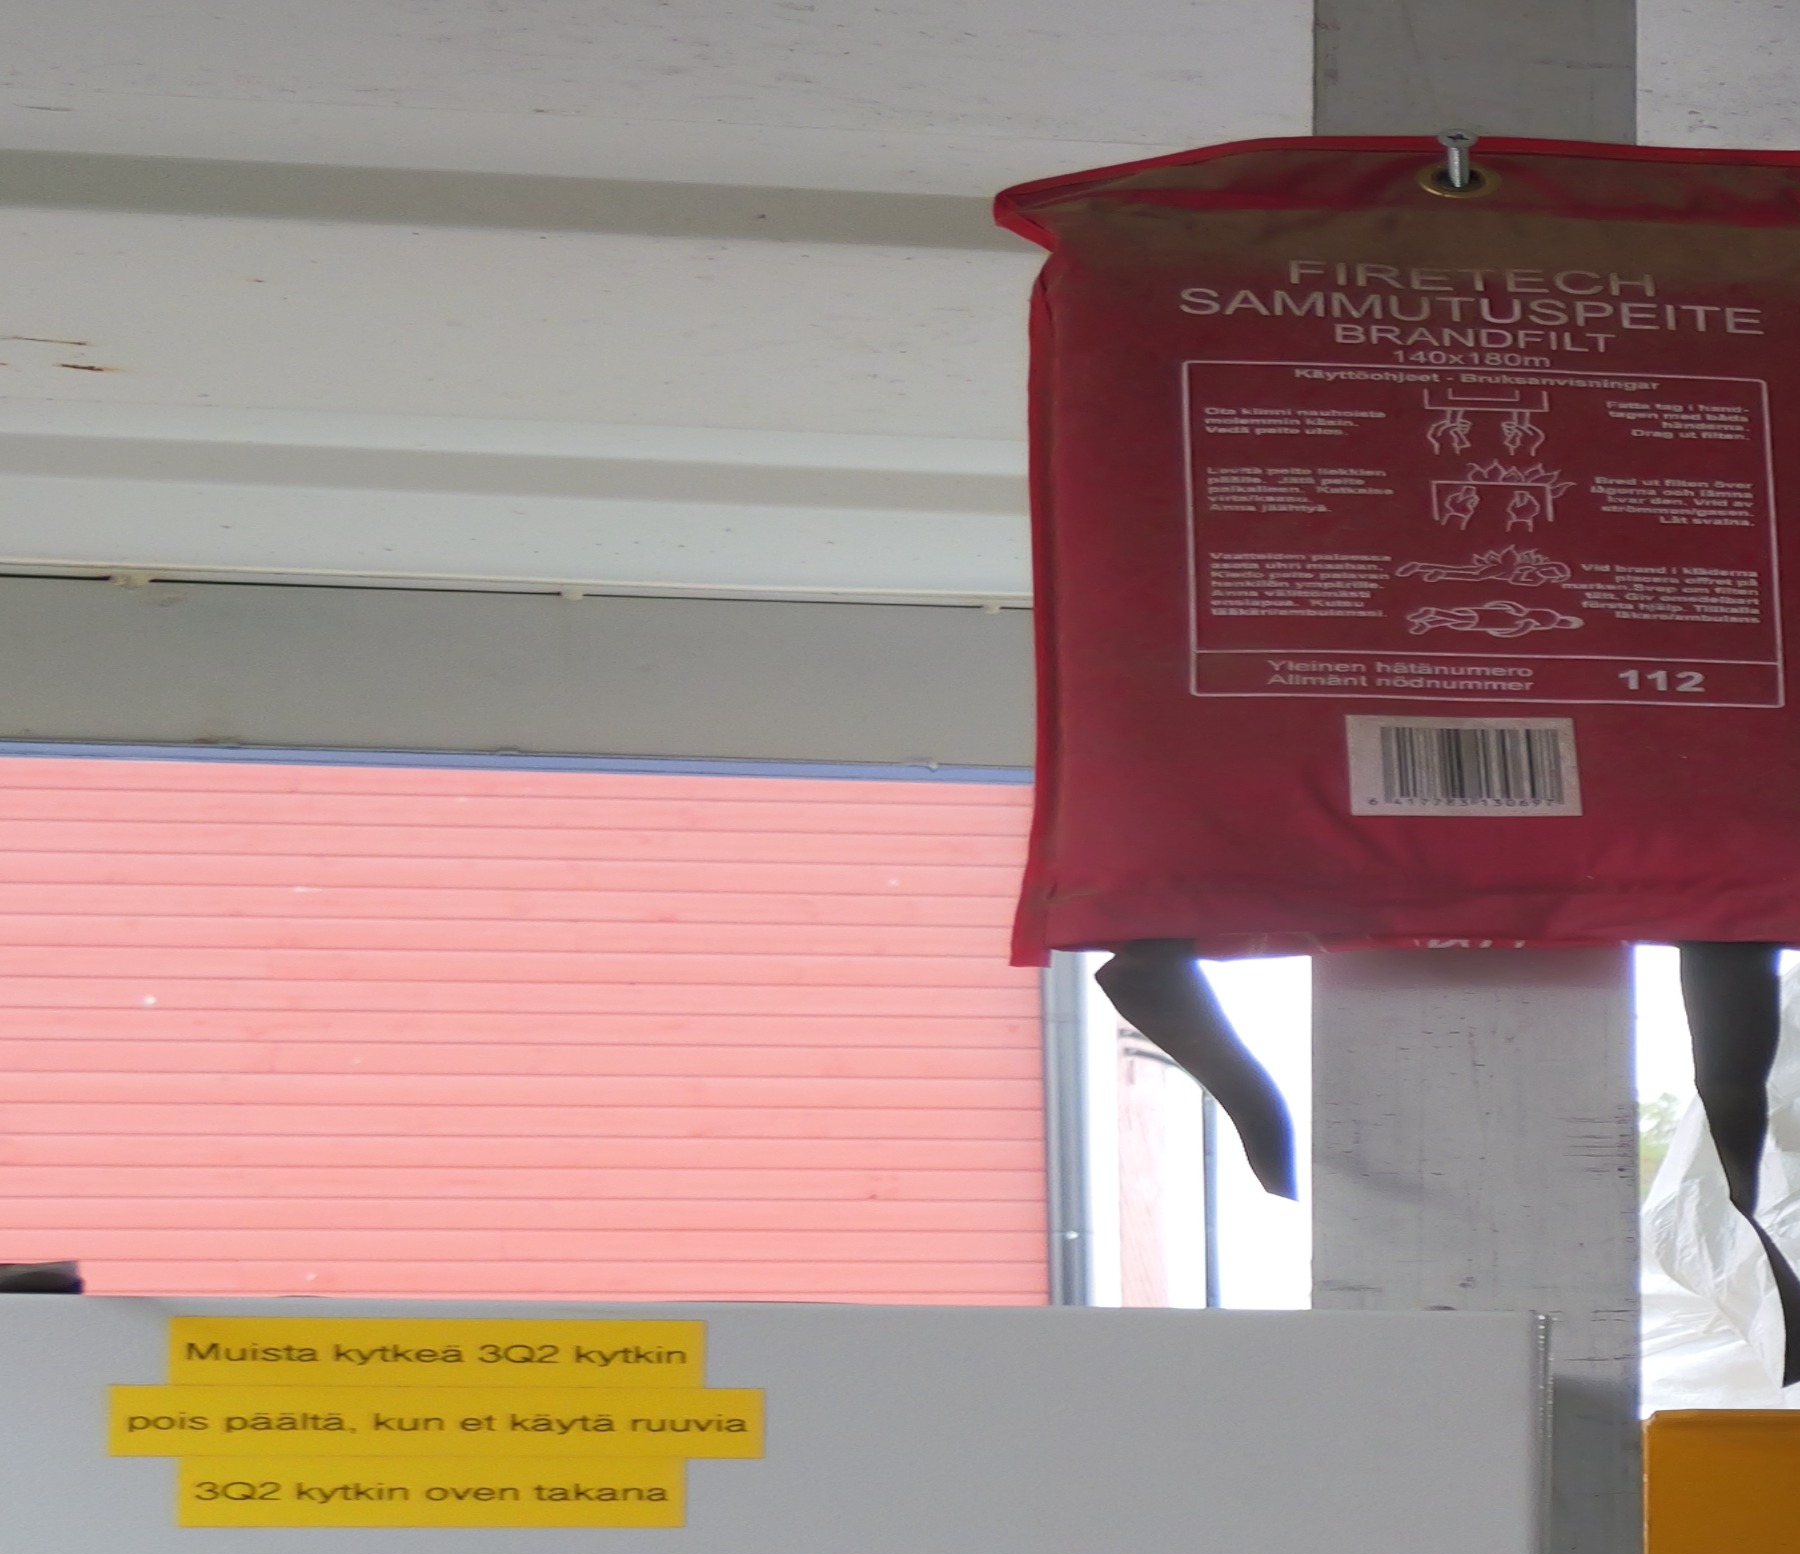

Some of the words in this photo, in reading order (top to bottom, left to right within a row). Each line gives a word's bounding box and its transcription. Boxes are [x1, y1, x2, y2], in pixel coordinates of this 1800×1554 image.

[1288, 260, 1657, 298] FIRETECH
[1178, 287, 1765, 336] SAMMUTUSPEITE
[1333, 323, 1618, 353] BRANDFILT
[1391, 350, 1553, 368] 140x180m
[1458, 373, 1662, 391] Bruksanvisningar
[1266, 660, 1367, 673] Yleinen
[1375, 662, 1534, 678] hätänumero
[1616, 669, 1707, 693] 112
[1266, 674, 1368, 687] Allmänt
[1375, 677, 1534, 691] nödnummer
[184, 1342, 319, 1363] Muista
[333, 1344, 465, 1366] kytkeä
[477, 1345, 559, 1364] 3Q2
[572, 1345, 688, 1367] kytkin
[126, 1411, 209, 1433] pois
[224, 1411, 358, 1434] päältä,
[372, 1413, 445, 1431] kun
[459, 1414, 496, 1431] et
[509, 1413, 616, 1435] käytä
[629, 1414, 748, 1432] ruuvia
[193, 1481, 282, 1502] 3Q2
[295, 1482, 410, 1504] kytkin
[424, 1486, 520, 1502] oven
[533, 1483, 670, 1502] takana
